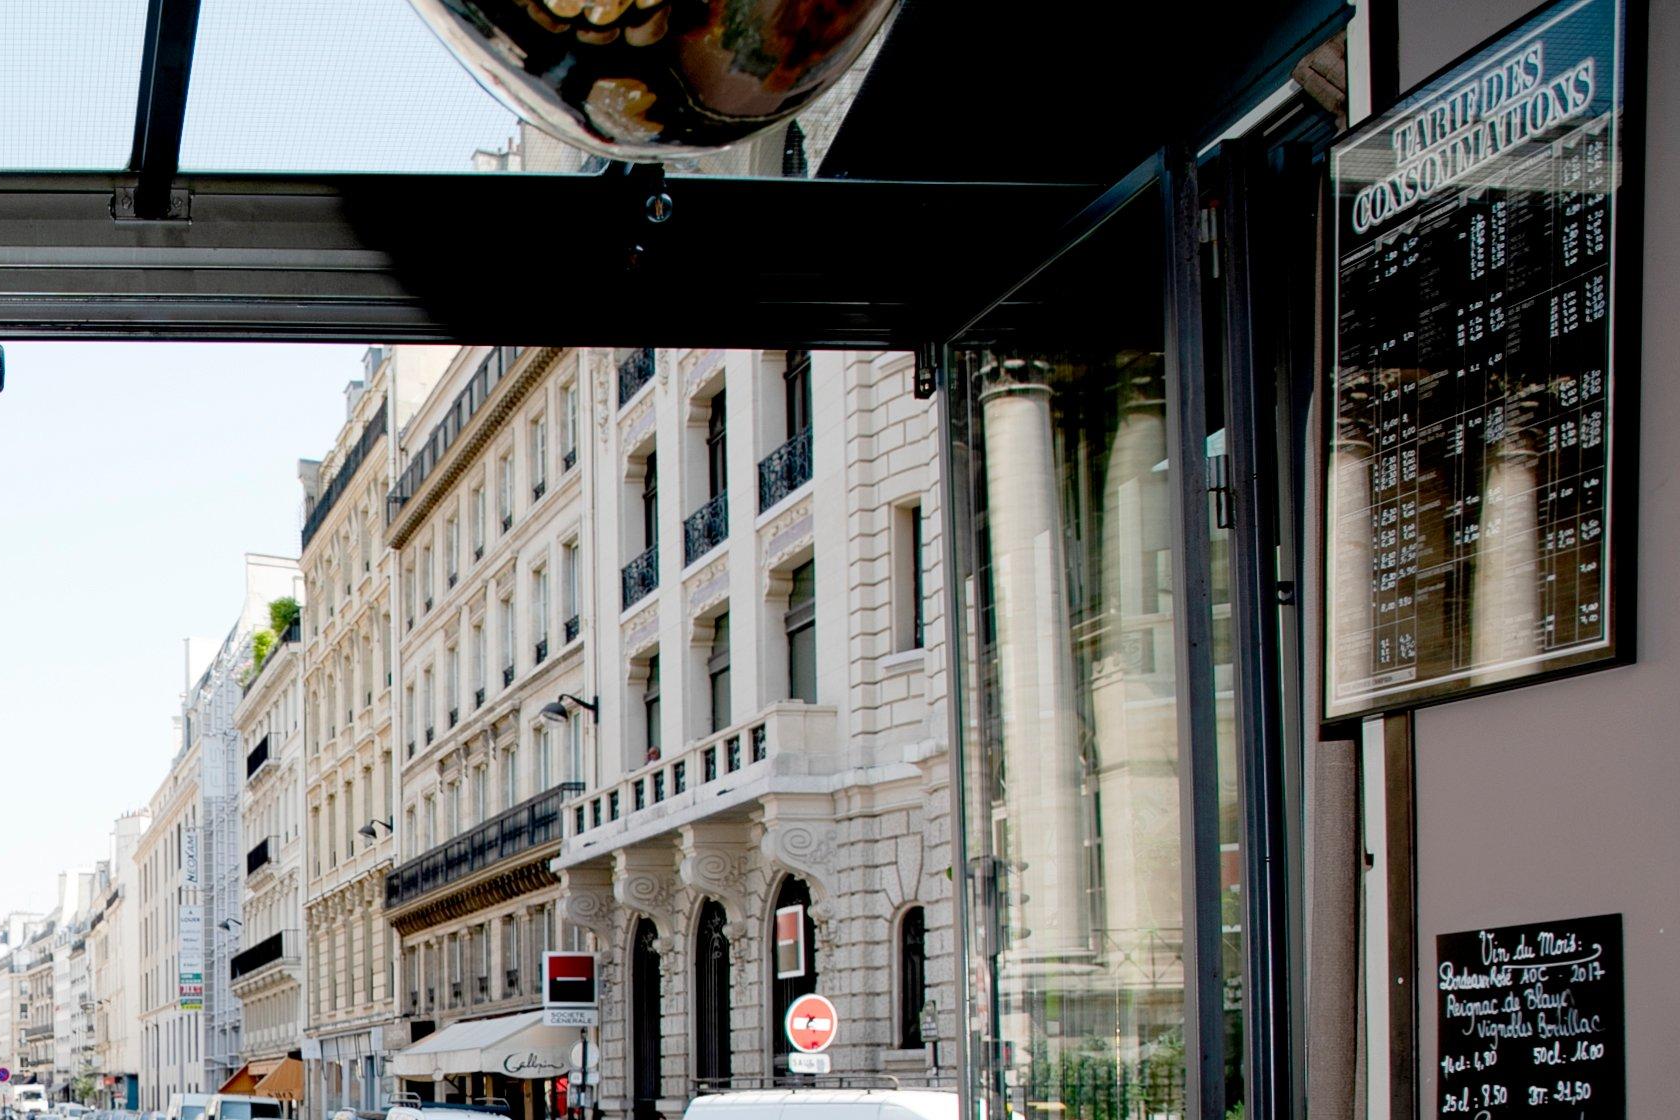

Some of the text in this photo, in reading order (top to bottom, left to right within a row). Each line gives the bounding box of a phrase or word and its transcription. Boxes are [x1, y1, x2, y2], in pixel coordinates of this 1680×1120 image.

[1392, 41, 1544, 169] TARIF DES
[1353, 57, 1596, 235] CONSOMMATIONS
[1479, 930, 1510, 965] Vin
[1513, 934, 1535, 960] du
[1570, 962, 1606, 983] 2017
[1501, 991, 1520, 1013] de
